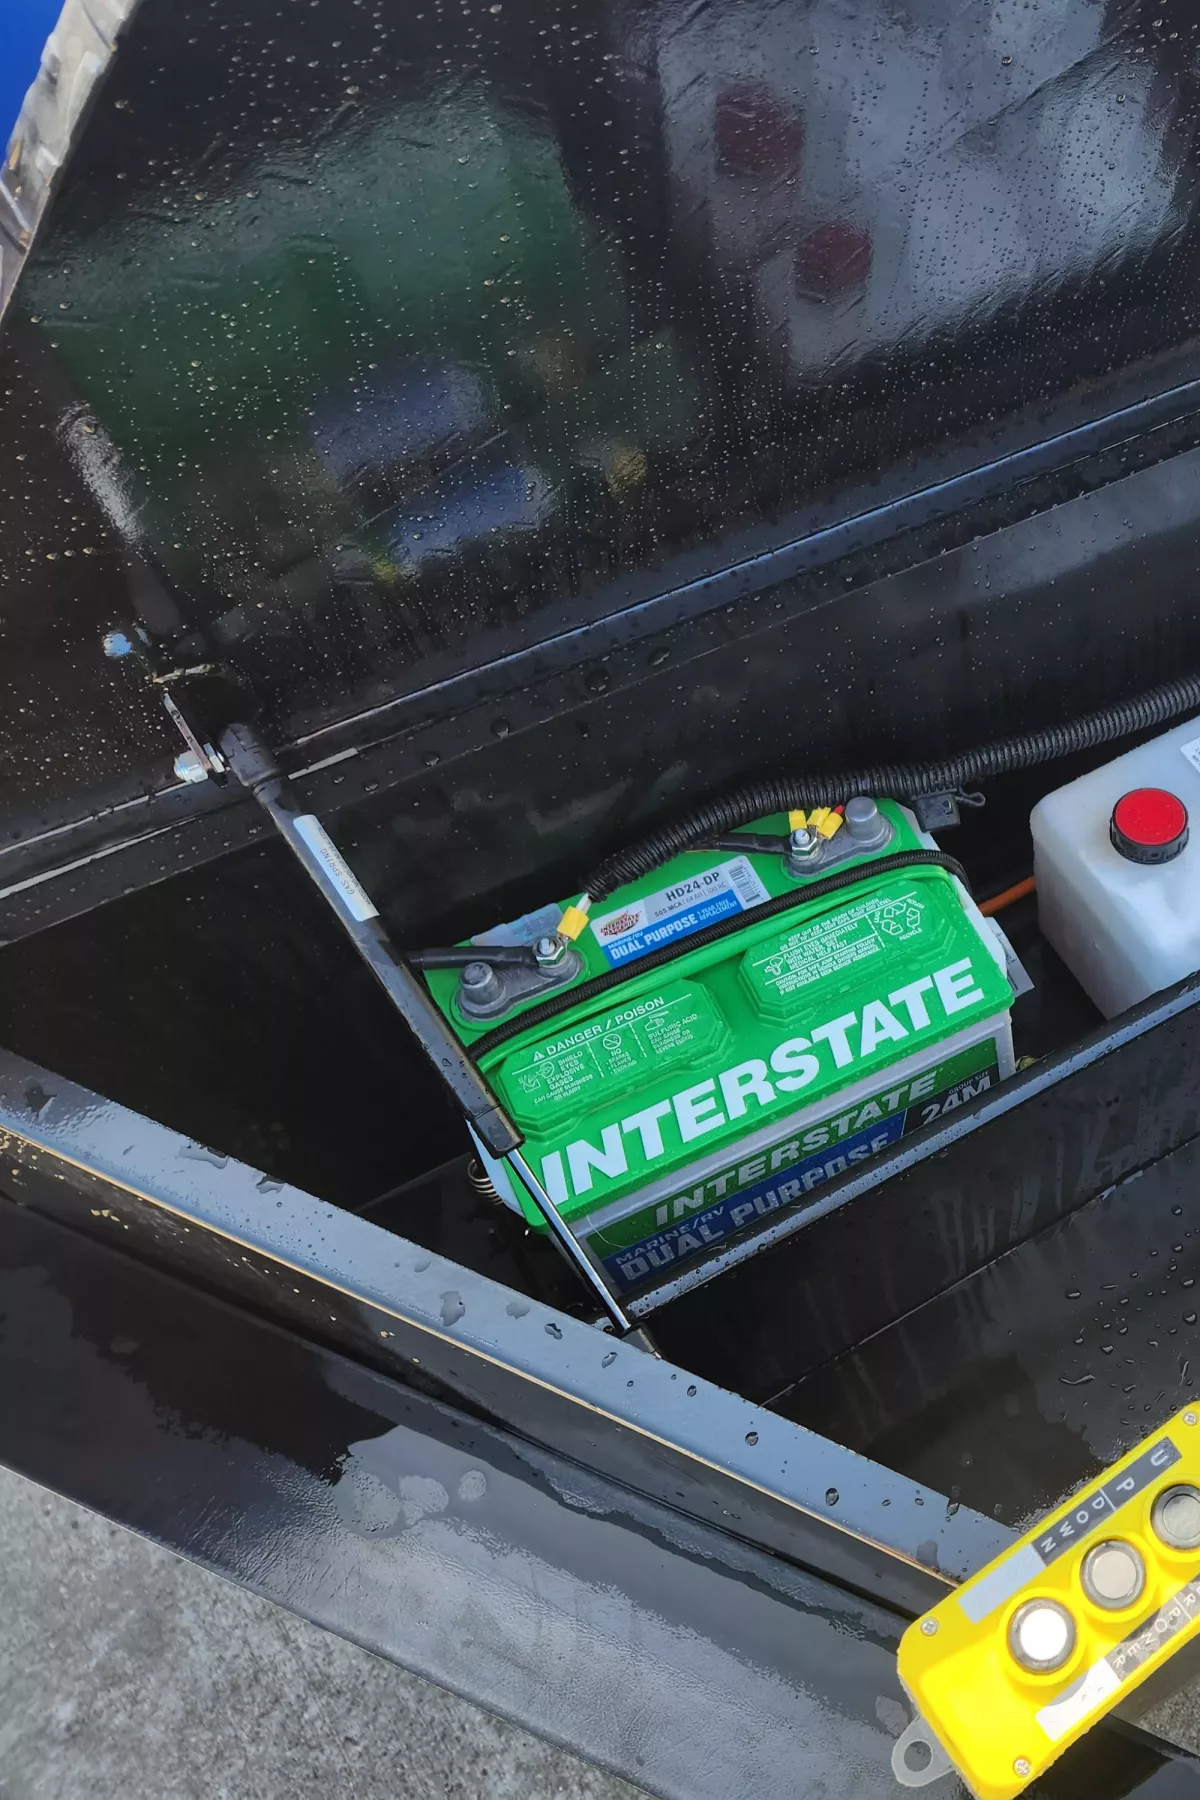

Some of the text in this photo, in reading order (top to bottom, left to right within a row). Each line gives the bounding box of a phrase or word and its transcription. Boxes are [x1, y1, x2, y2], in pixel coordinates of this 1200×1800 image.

[319, 848, 354, 894] GAS SPRING
[666, 872, 719, 901] HD24-DP
[668, 902, 682, 910] MCA
[699, 901, 736, 920] REPLACEMENT
[601, 913, 638, 932] INTERSTATE
[604, 916, 638, 936] BATTERIES
[899, 928, 923, 941] RECYCLE
[608, 931, 642, 949] MARINE/RV
[611, 914, 697, 959] DUAL PURPOSE
[783, 922, 857, 959] FLUSH EYES IMMEDIATELY
[786, 955, 802, 964] WITH
[826, 938, 837, 947] GET
[790, 956, 815, 970] MEDICAL
[816, 948, 831, 958] HELP
[547, 1025, 602, 1054] DANGER
[615, 997, 663, 1024] POISON
[648, 1014, 697, 1039] SULFURIC ACID
[663, 1028, 680, 1038] CAUSE
[558, 1051, 582, 1065] SHIELD
[611, 1048, 621, 1056] NO
[547, 1063, 584, 1084] EXPLOSIVE
[560, 1060, 579, 1071] EYES
[534, 1074, 593, 1103] CAN CAUSE BLINDNESS
[541, 957, 984, 1206] INTERSTATE
[550, 1076, 573, 1089] GASES
[562, 1086, 580, 1097] INJURY
[948, 1069, 989, 1095] GROUP SIZE
[921, 1075, 991, 1125] 24M
[656, 1071, 936, 1226] INTERSTATE
[620, 1132, 889, 1280] DUAL PURPOSE
[616, 1206, 725, 1265] MARINE/RV
[1117, 1450, 1168, 1492] UP
[1041, 1497, 1104, 1553] DOWN
[1113, 1607, 1181, 1667] POWER
